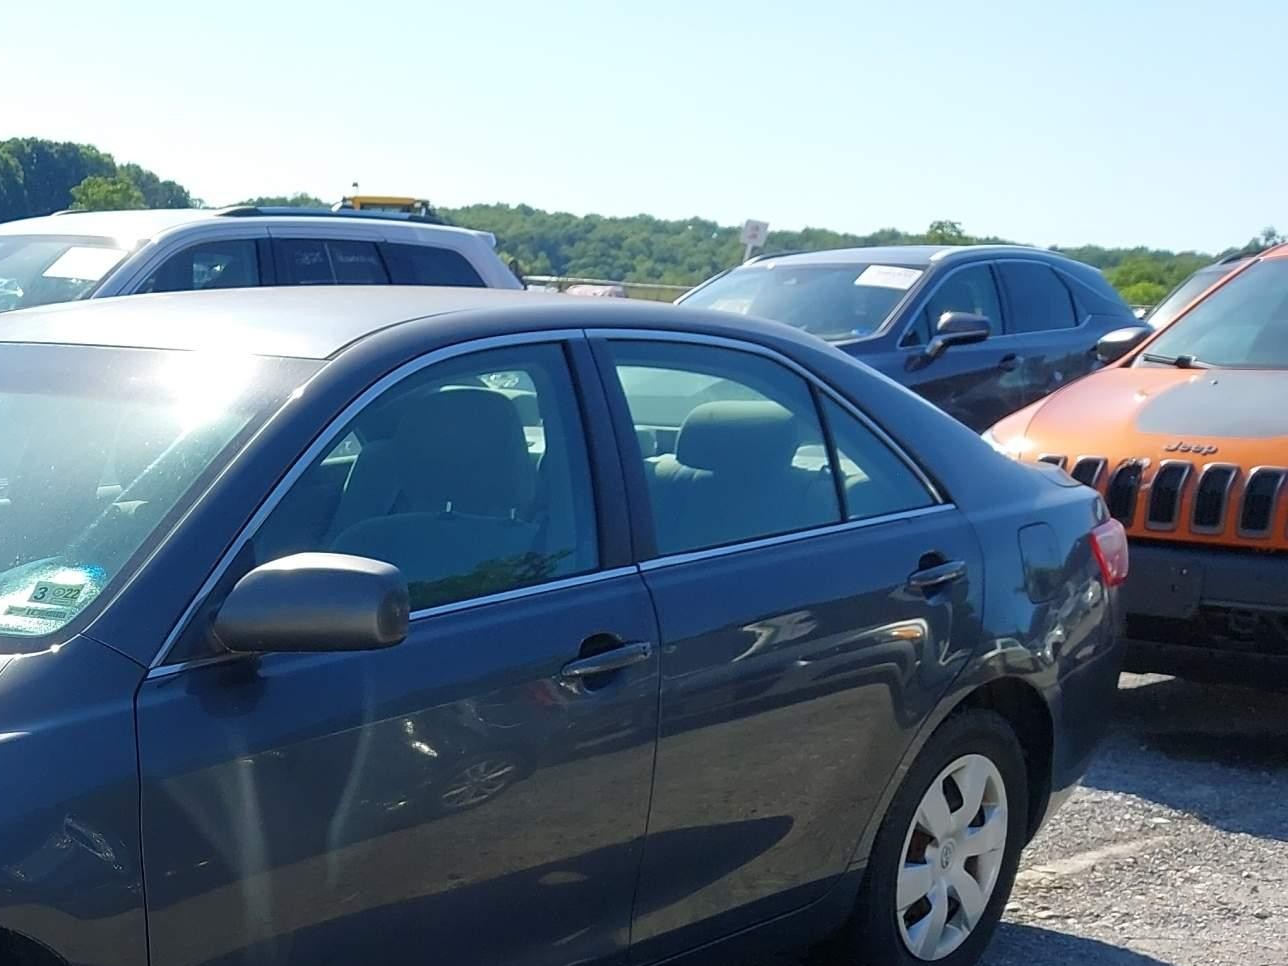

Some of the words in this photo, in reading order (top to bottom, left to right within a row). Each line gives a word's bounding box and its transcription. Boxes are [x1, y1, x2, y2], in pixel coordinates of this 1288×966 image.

[1164, 441, 1218, 456] Jeep
[33, 586, 48, 600] 3
[62, 588, 81, 600] 22
